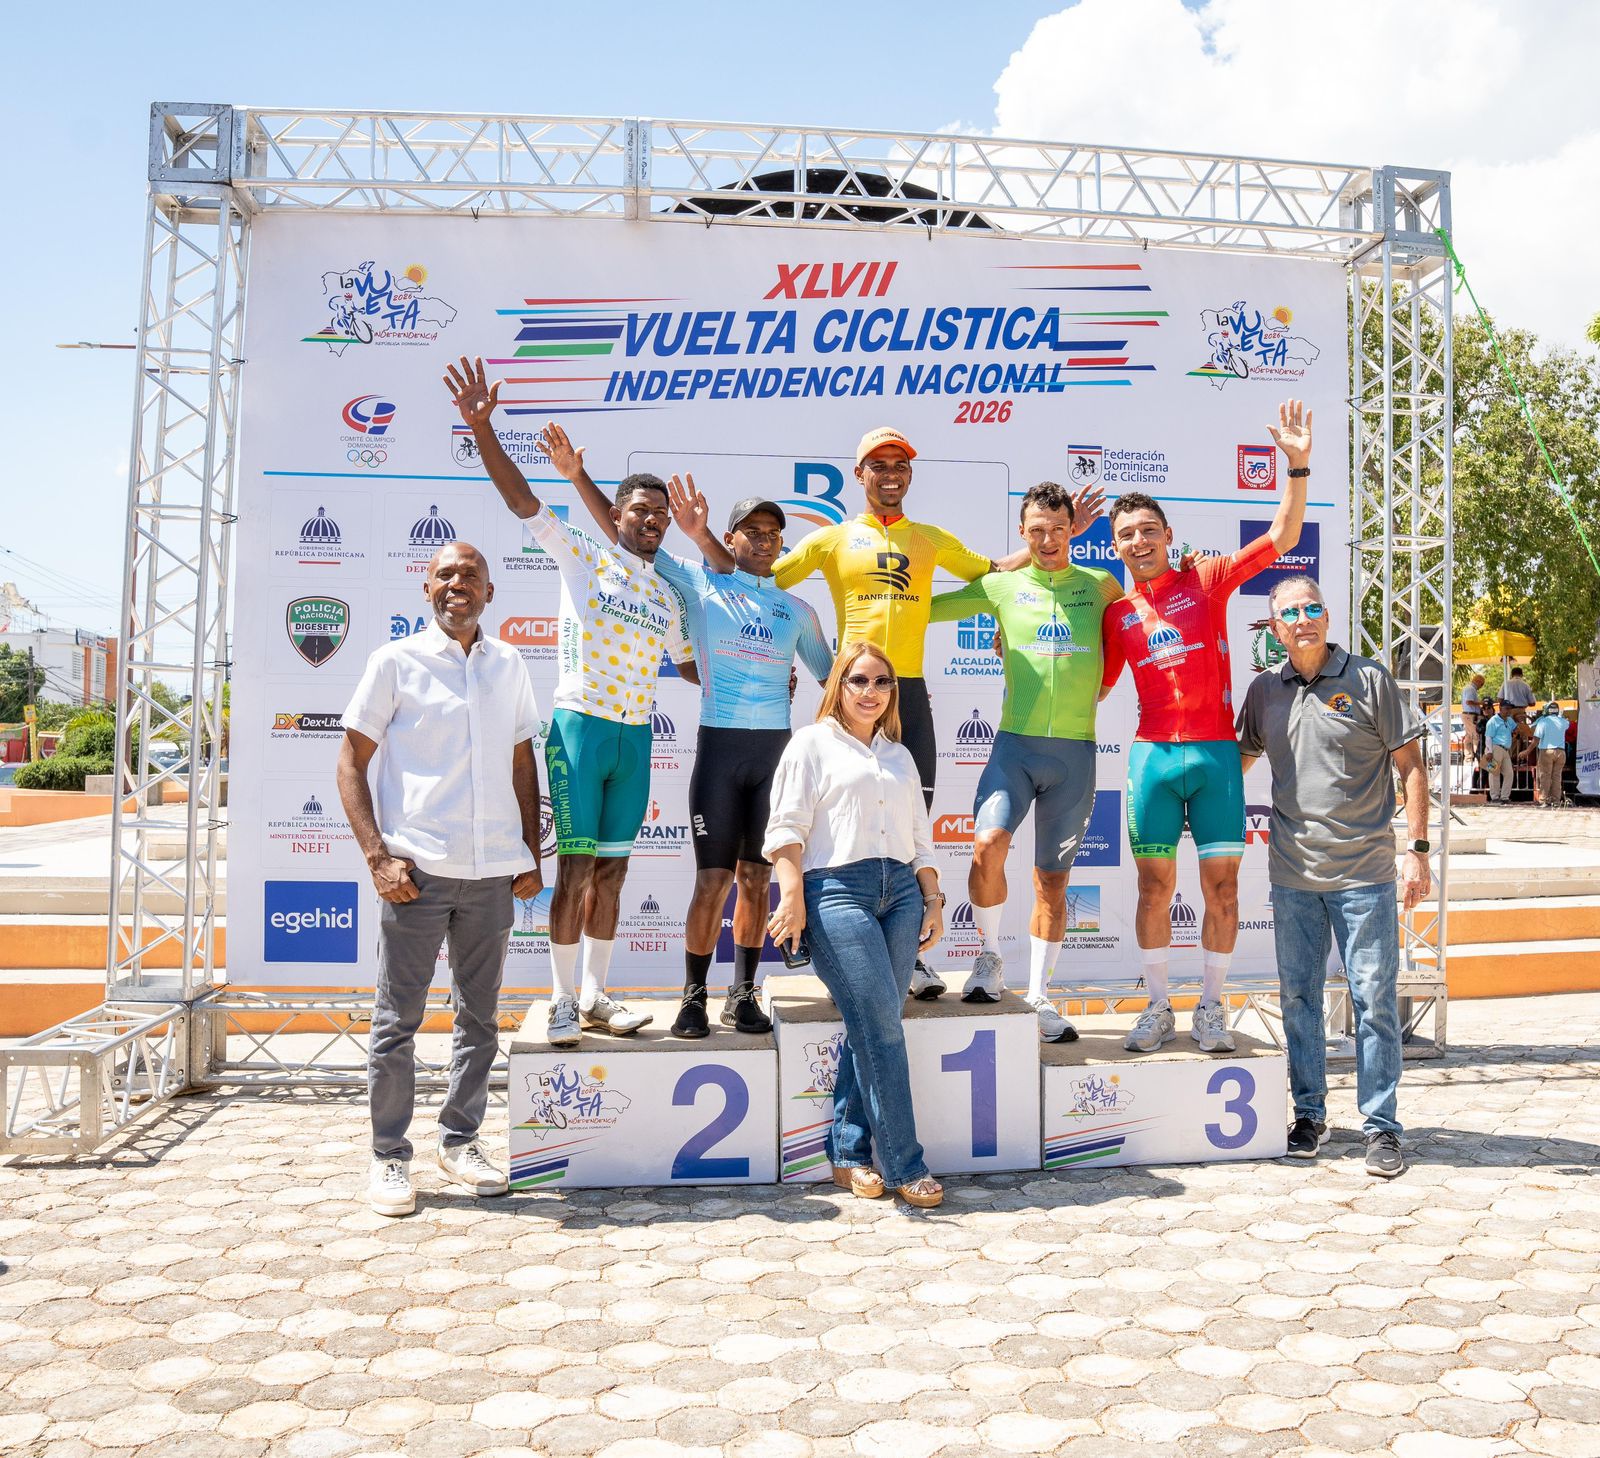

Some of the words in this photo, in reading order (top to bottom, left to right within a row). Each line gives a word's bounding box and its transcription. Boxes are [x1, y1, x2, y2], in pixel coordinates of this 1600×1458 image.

[763, 261, 898, 300] XLVII
[626, 310, 797, 358] VUELTA
[812, 306, 1062, 355] CICLISTICA
[603, 365, 884, 403] INDEPENDENCIA
[894, 362, 1067, 397] NACIONAL
[953, 400, 1013, 424] 2026
[1103, 449, 1165, 461] Federación
[1103, 460, 1169, 473] Dominicana
[1103, 471, 1117, 481] de
[1118, 471, 1166, 483] Ciclismo
[275, 549, 316, 557] REPÚBLICA
[317, 551, 365, 559] DOMINICANA
[387, 551, 429, 559] REPÚBLICA
[503, 556, 534, 564] EMPRESA
[534, 556, 544, 564] DE
[505, 563, 542, 571] ELÉCTRICA
[857, 593, 920, 602] BANRESERVAS
[294, 603, 344, 617] POLICIA
[300, 612, 338, 621] NACIONAL
[601, 603, 641, 625] Energía
[640, 619, 666, 637] Limpia
[295, 623, 341, 631] DIGESETT
[950, 656, 1002, 666] ALCALDÍA
[944, 667, 958, 675] LA
[960, 667, 1005, 676] ROMANA
[650, 762, 680, 770] RTES
[268, 820, 308, 828] REPÚBLICA
[309, 821, 352, 829] DOMINICAN
[640, 825, 689, 839] RANT
[292, 842, 330, 854] INEFI
[1079, 841, 1110, 850] omingo
[270, 907, 353, 934] egehid
[647, 920, 687, 928] DOMINICAN
[1079, 935, 1120, 943] TRANSMISIÓN
[629, 941, 667, 952] INEFI
[941, 1029, 997, 1158] 1
[1204, 1066, 1258, 1150] 3
[670, 1063, 750, 1180] 2
